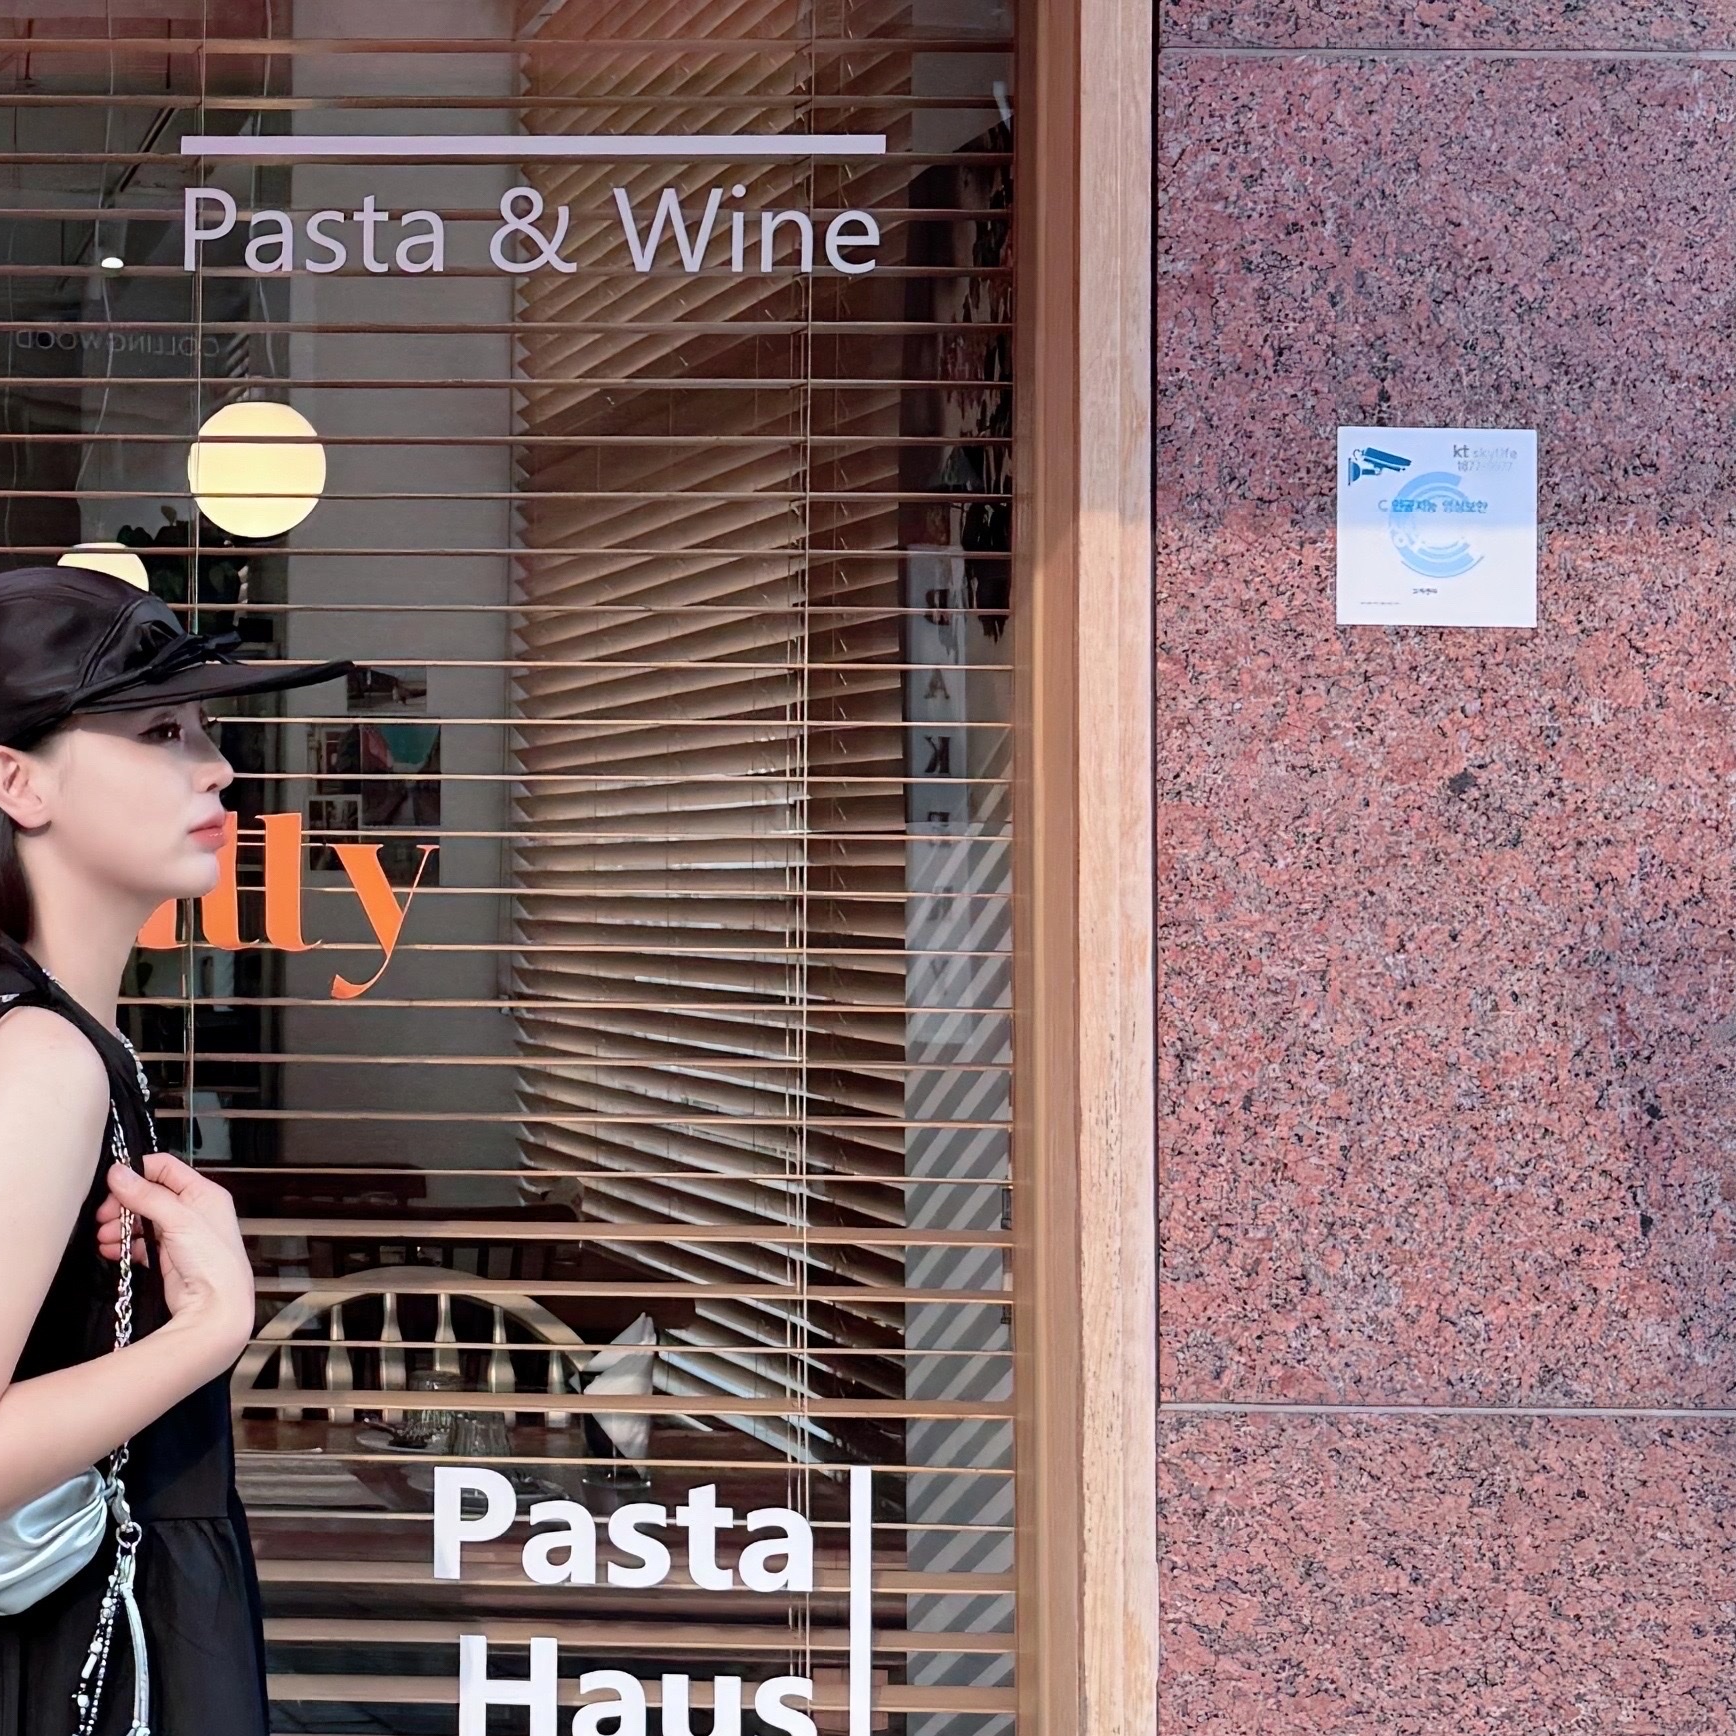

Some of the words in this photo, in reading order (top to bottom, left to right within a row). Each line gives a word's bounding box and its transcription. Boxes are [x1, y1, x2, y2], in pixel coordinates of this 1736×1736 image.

[183, 186, 445, 274] Pasta
[488, 186, 578, 274] &
[613, 184, 881, 275] Wine
[432, 1465, 815, 1594] Pasta
